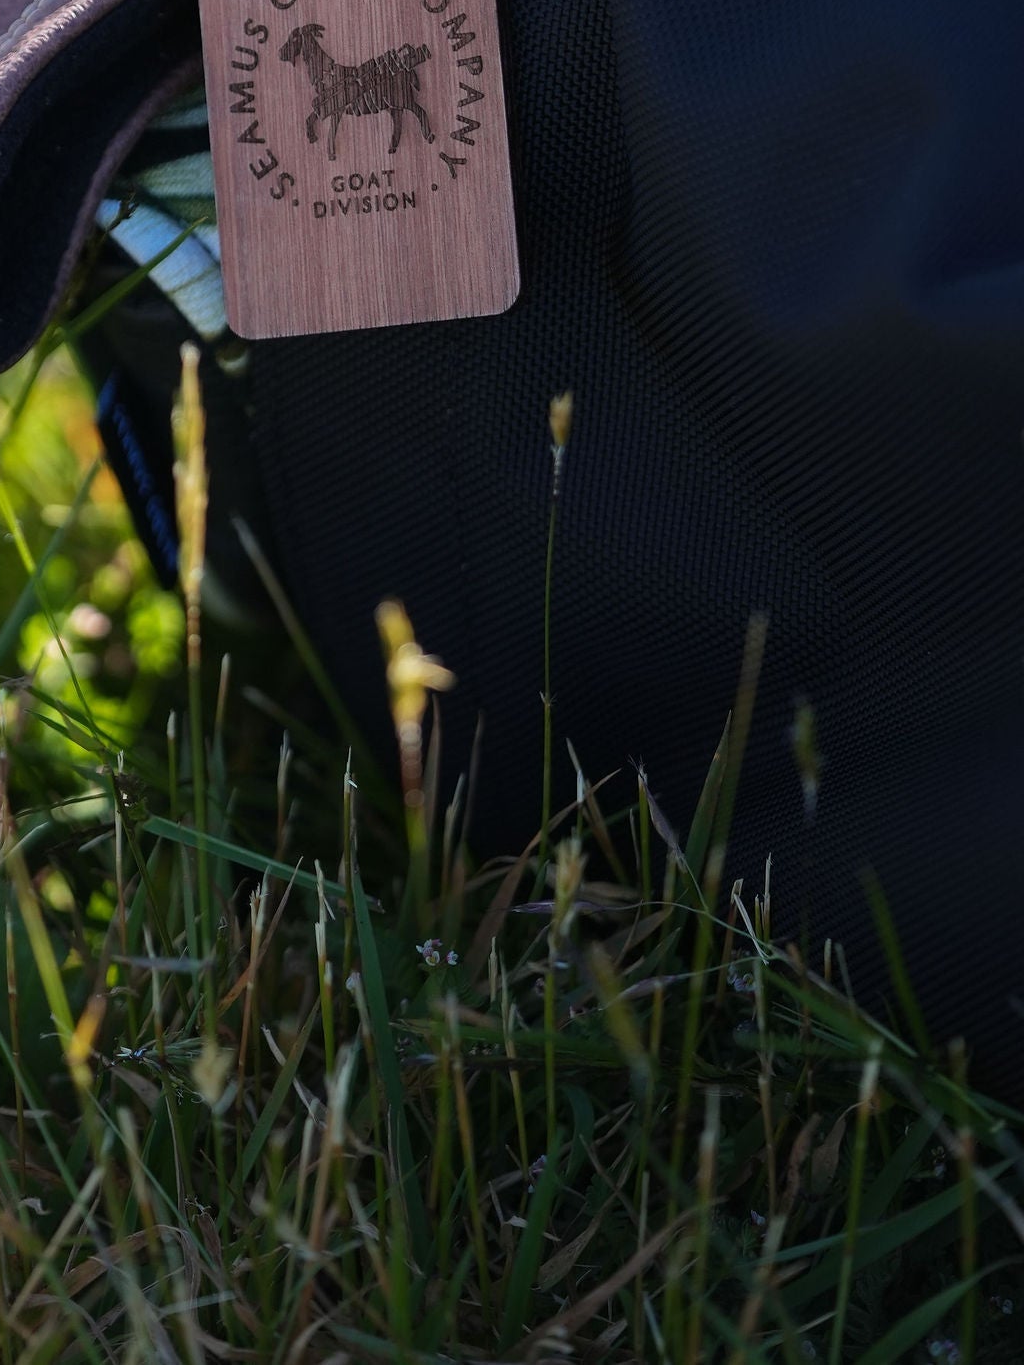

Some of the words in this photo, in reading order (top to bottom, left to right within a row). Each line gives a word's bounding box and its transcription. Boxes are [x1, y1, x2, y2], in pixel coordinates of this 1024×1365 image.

[229, 18, 295, 201] SEAMUS
[331, 170, 394, 193] GOAT
[313, 192, 416, 218] DIVISION
